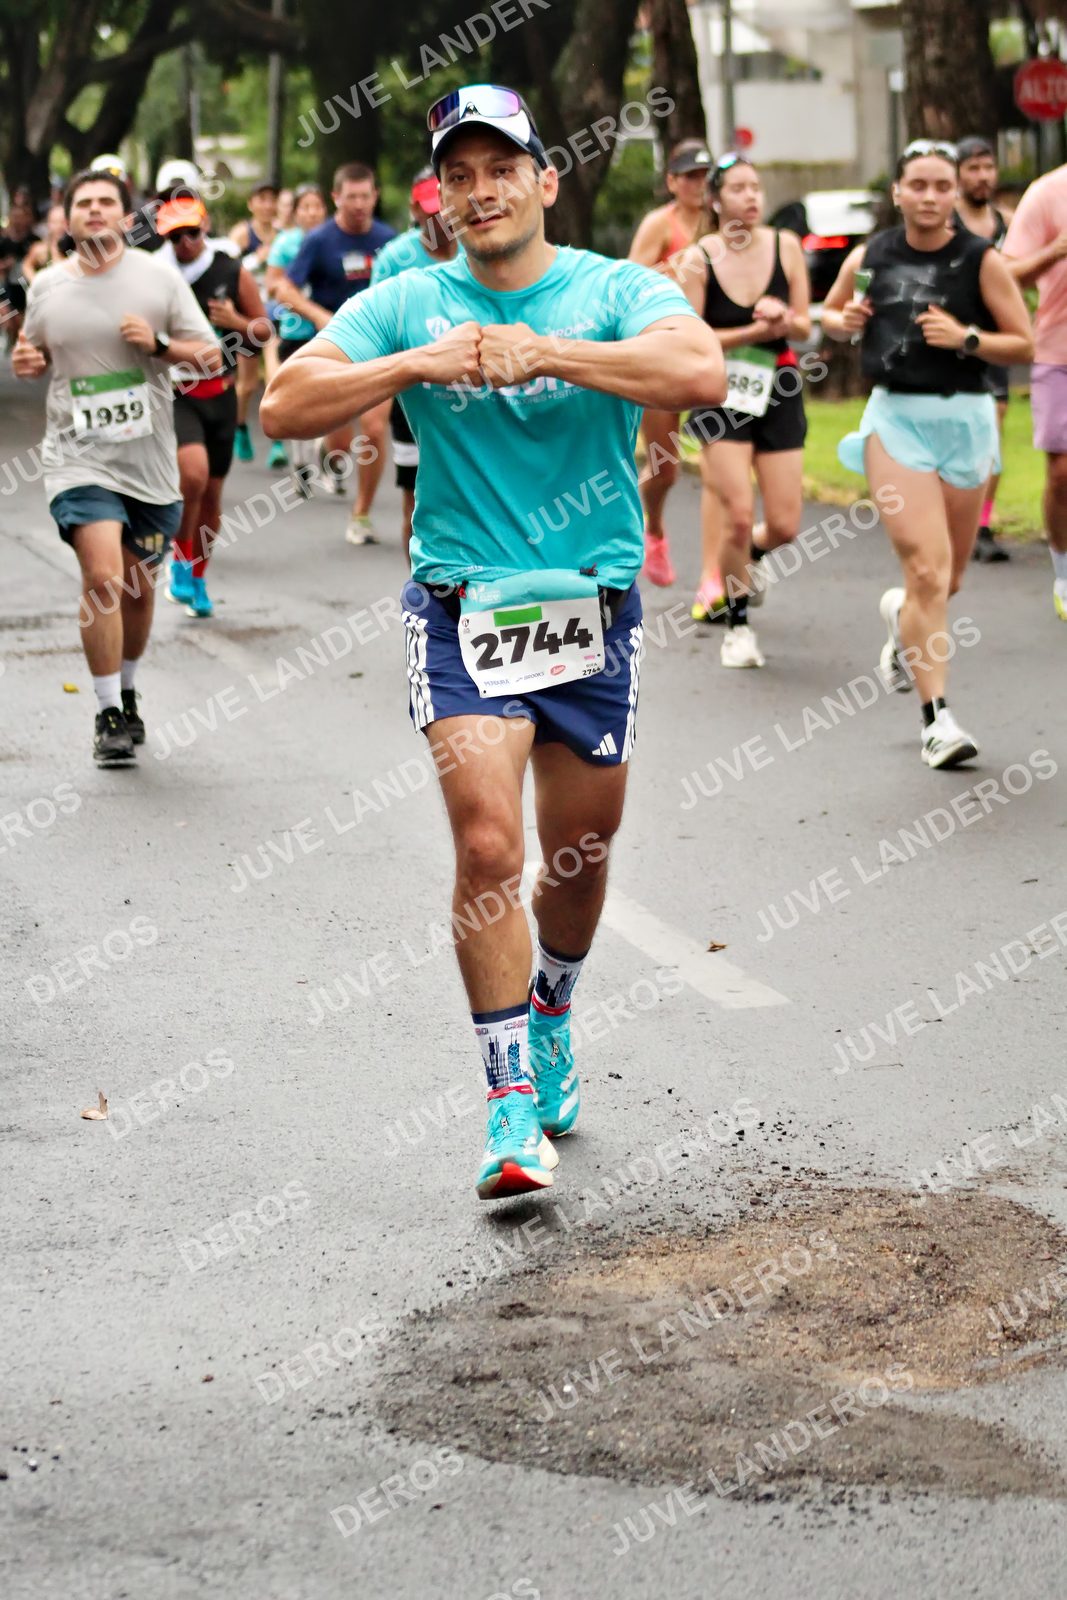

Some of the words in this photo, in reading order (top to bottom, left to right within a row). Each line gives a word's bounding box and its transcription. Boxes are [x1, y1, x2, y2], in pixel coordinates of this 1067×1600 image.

[82, 401, 144, 429] 1939
[470, 617, 593, 671] 2744
[582, 667, 601, 676] 2744
